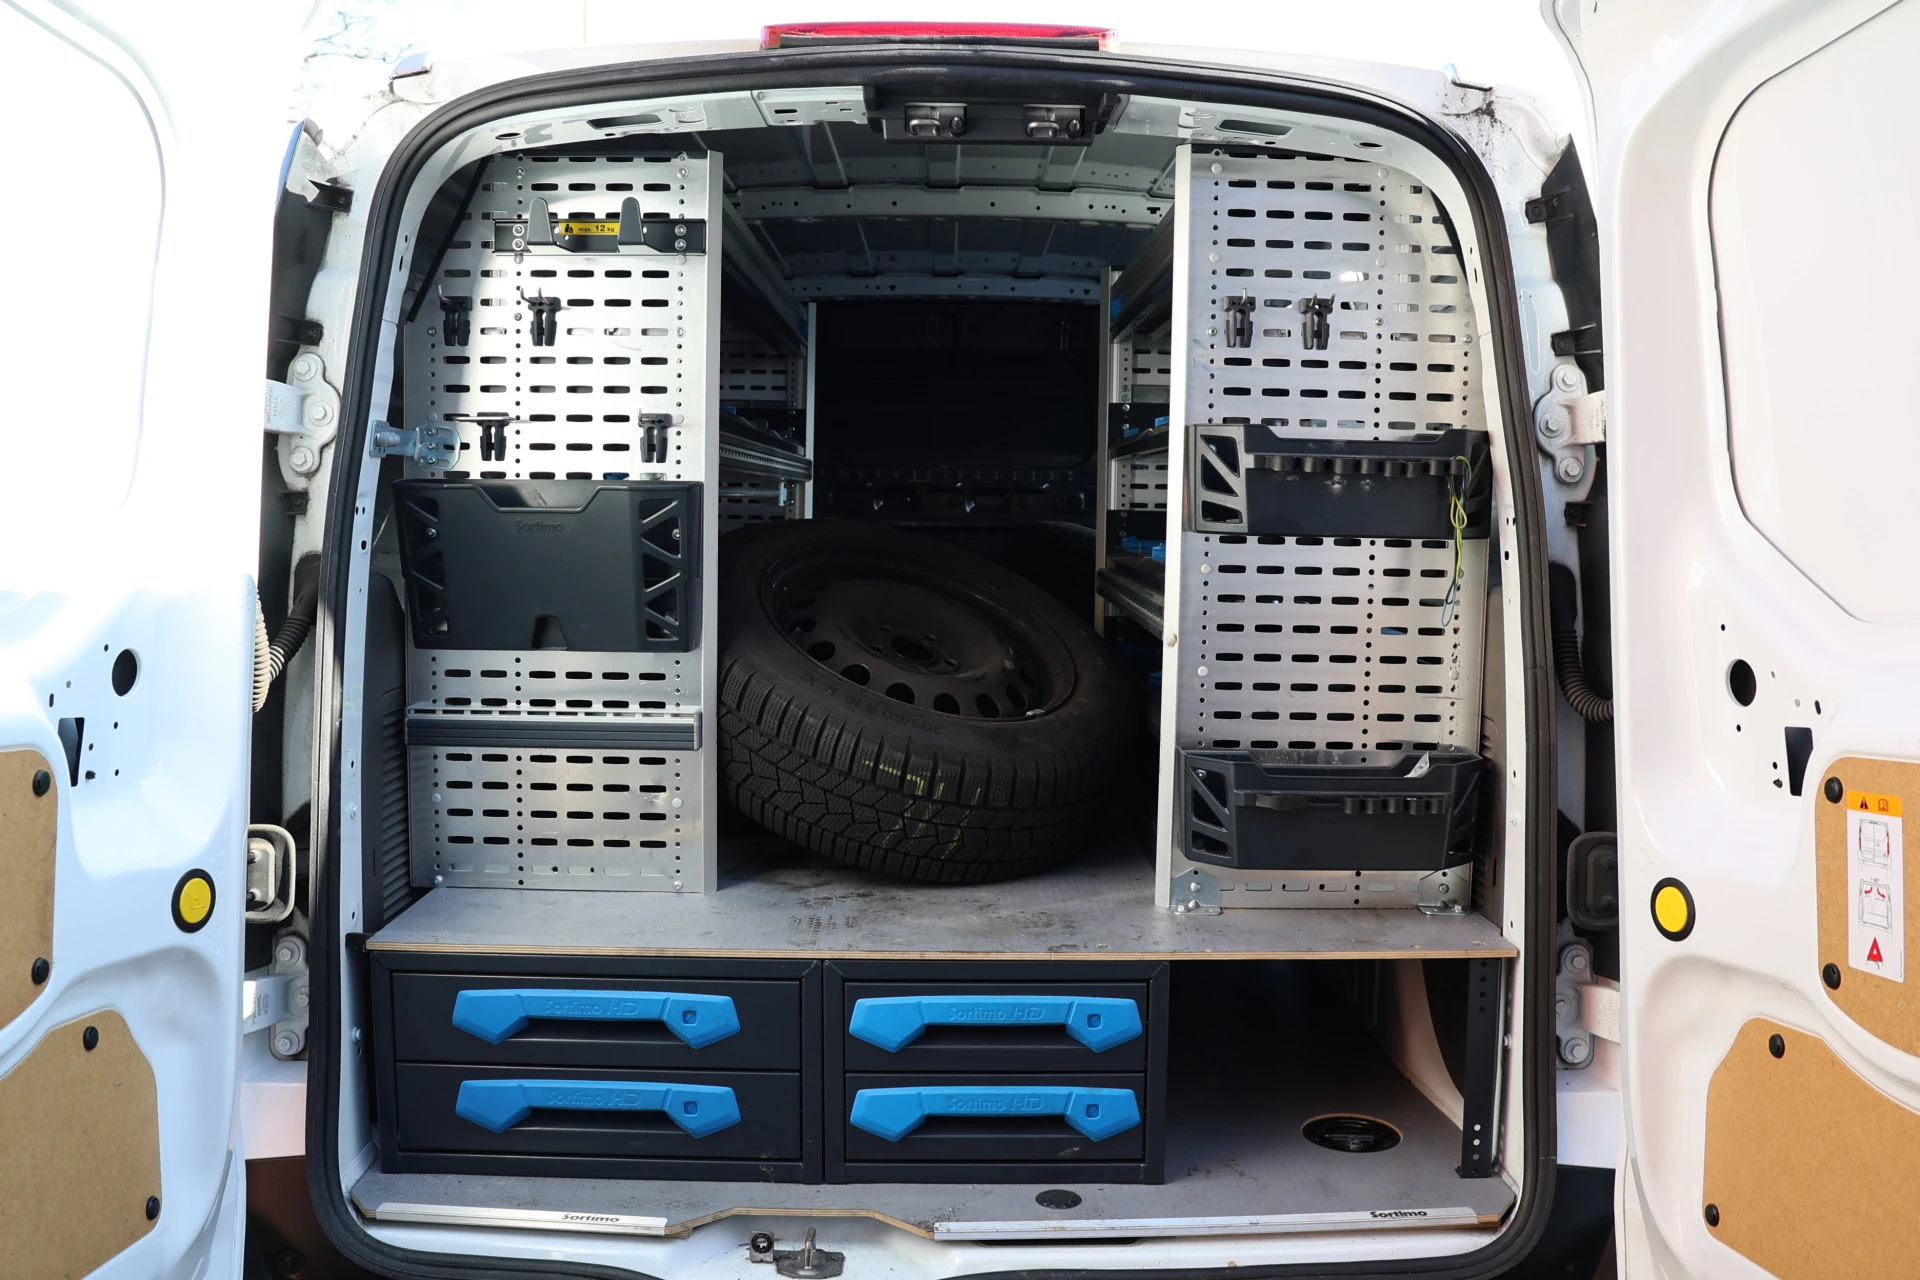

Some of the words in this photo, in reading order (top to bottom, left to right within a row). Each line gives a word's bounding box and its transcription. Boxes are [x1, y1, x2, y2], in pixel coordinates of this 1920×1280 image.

[595, 224, 606, 232] 12
[544, 1000, 601, 1015] Sortimo
[605, 1000, 640, 1015] HD
[948, 1005, 1006, 1021] Sortimo
[1011, 1005, 1045, 1021] HD
[607, 1090, 641, 1106] HD
[948, 1094, 1006, 1111] Sortimo
[1010, 1097, 1044, 1111] HD
[562, 1213, 620, 1222] Sortimo
[1370, 1210, 1428, 1218] Sortimo
